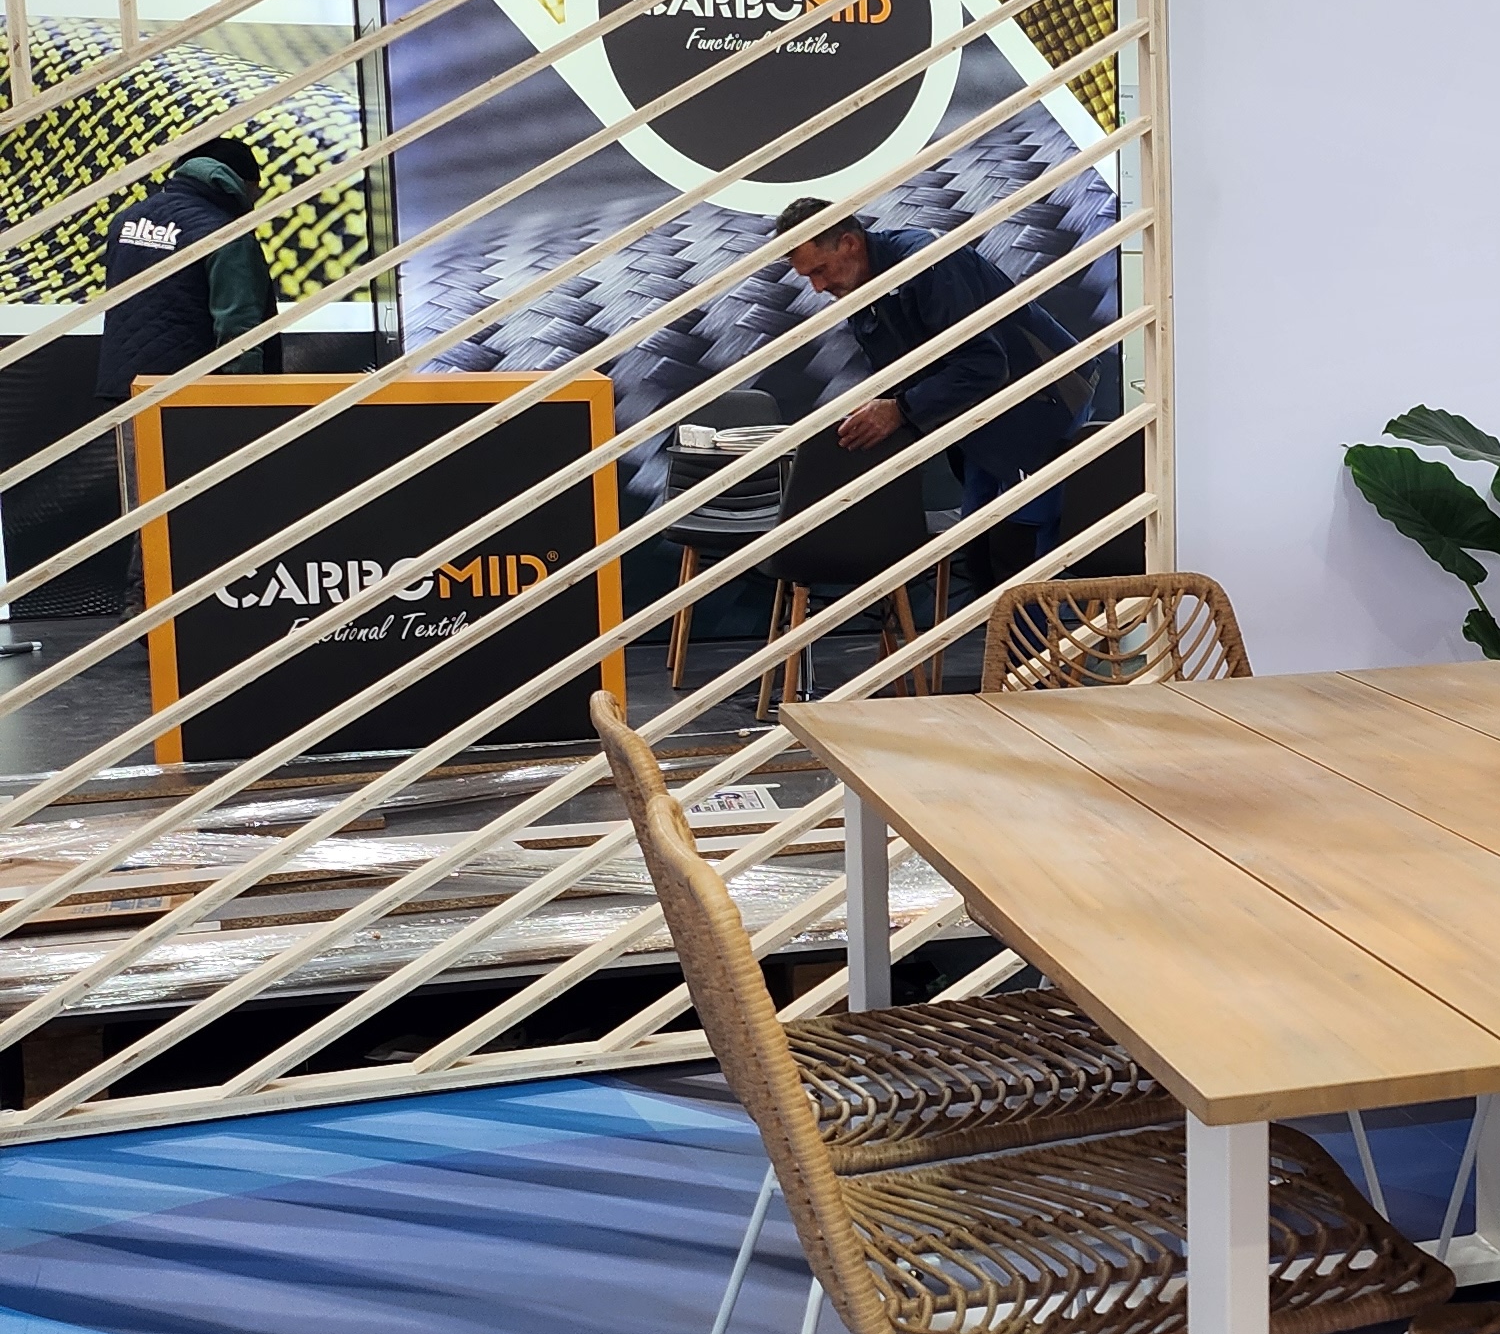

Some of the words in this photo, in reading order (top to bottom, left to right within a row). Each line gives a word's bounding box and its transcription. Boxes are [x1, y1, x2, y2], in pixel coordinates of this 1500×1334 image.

[685, 27, 772, 52] Function
[121, 217, 182, 245] altek
[286, 614, 395, 644] Ftional
[401, 610, 471, 640] Textil
